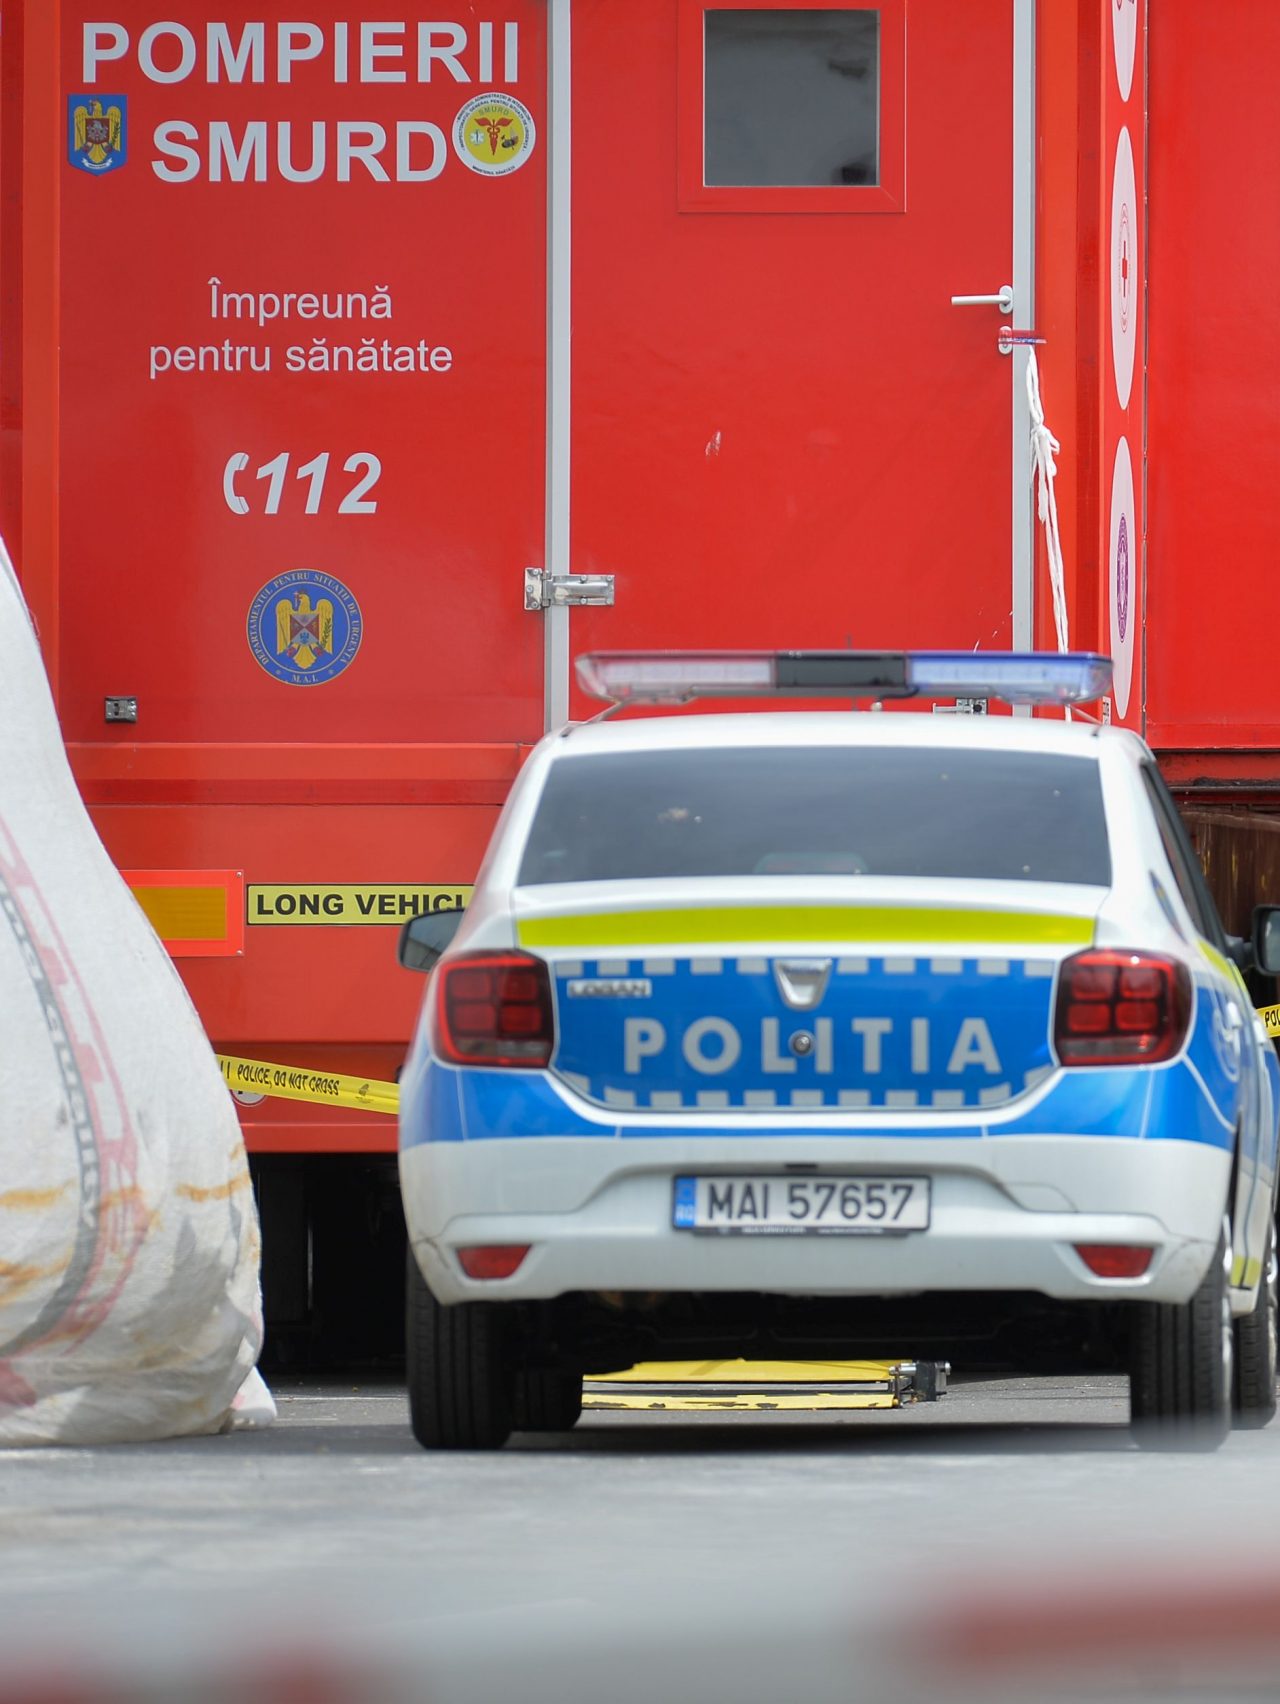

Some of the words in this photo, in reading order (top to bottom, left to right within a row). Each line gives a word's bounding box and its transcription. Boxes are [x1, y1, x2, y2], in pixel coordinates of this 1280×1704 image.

[84, 22, 517, 83] POMPIERII
[153, 121, 446, 182] SMURD
[209, 277, 391, 326] Împreună
[151, 340, 270, 379] pentru
[287, 338, 451, 371] sănătate
[257, 453, 381, 514] 112
[250, 588, 273, 665] DEPARTAMENTUL
[274, 572, 309, 588] PENTRU
[347, 602, 357, 616] DE
[258, 894, 343, 915] LONG
[624, 1017, 1003, 1074] POLITIA
[237, 1064, 272, 1089] POLICE,
[273, 1070, 286, 1087] DO
[288, 1072, 309, 1091] NOT
[308, 1076, 340, 1096] CROSS
[708, 1183, 769, 1220] MAI
[787, 1183, 914, 1220] 57657
